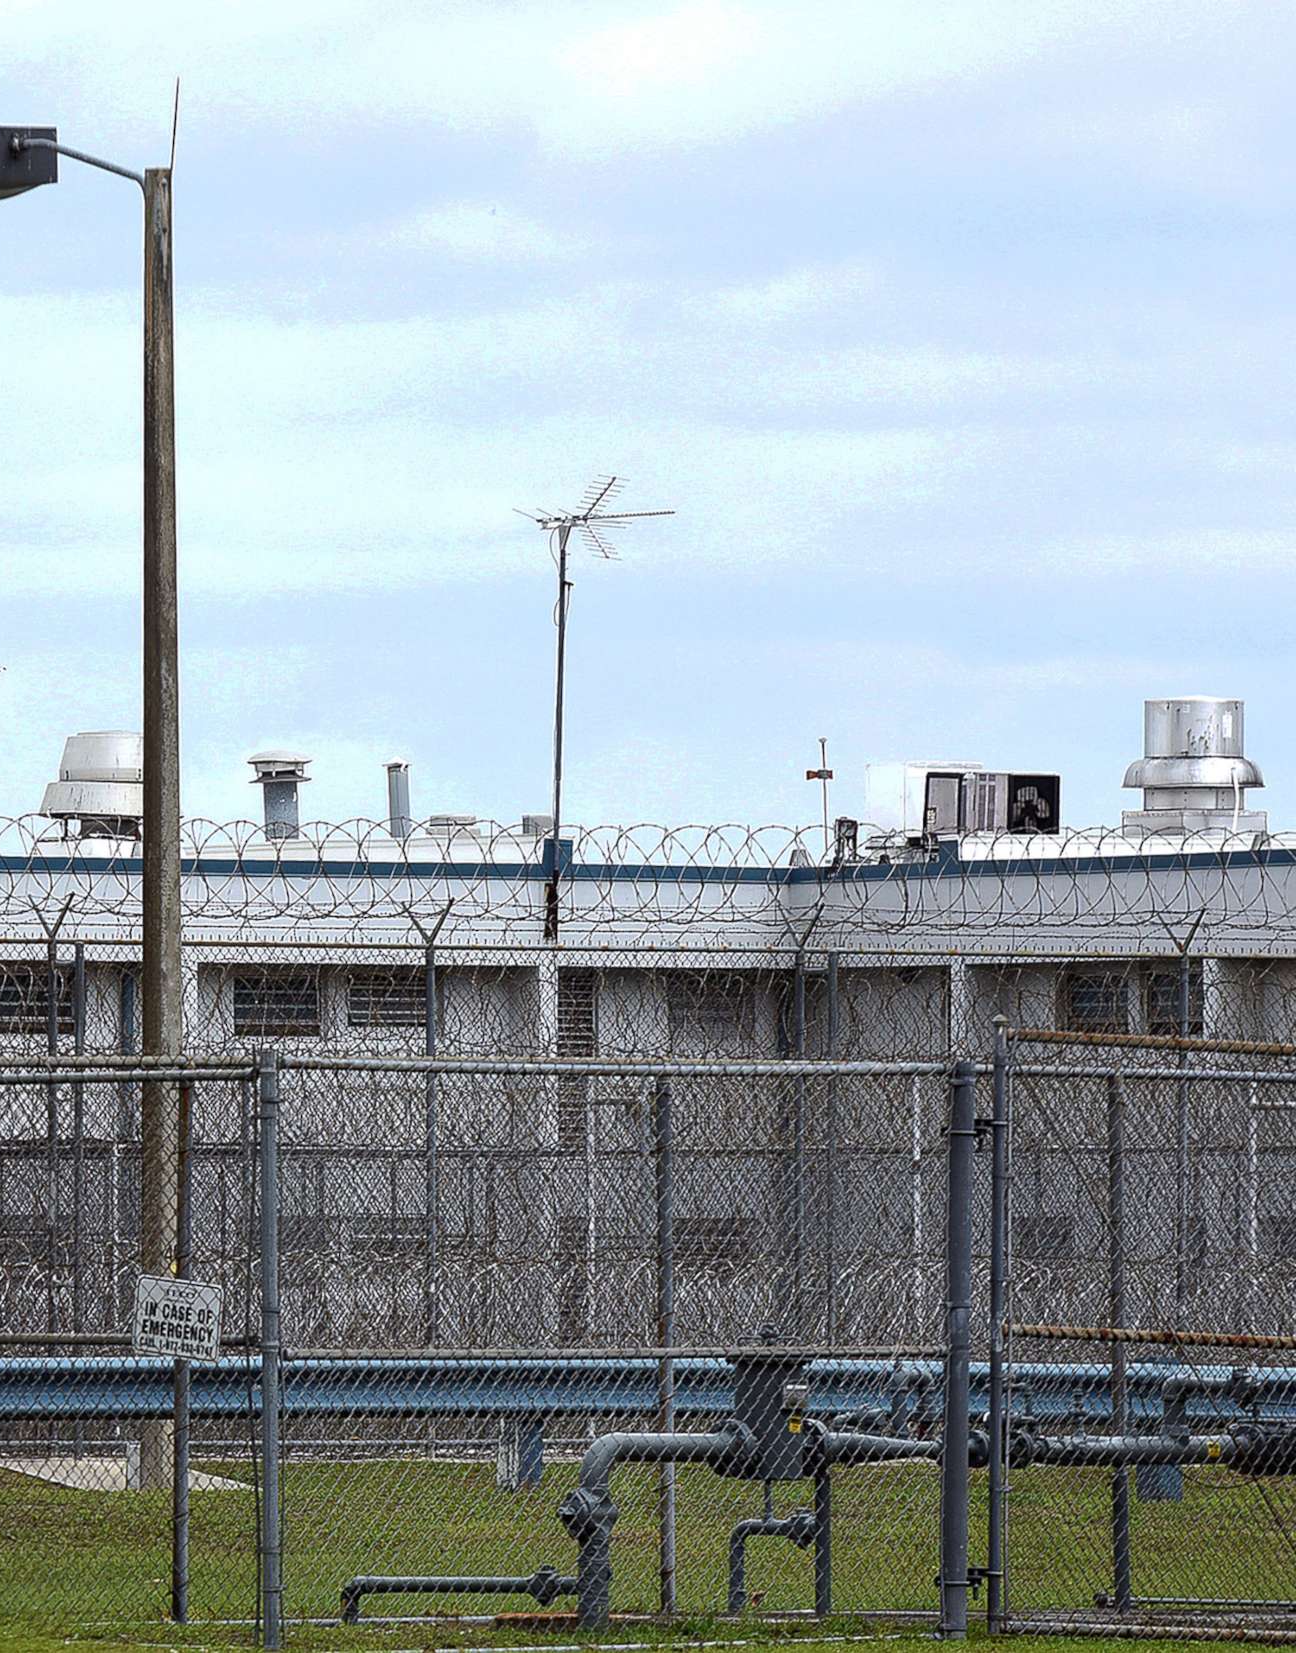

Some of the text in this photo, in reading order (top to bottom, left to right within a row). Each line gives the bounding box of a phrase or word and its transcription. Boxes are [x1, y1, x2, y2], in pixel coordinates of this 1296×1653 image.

[145, 1301, 214, 1325] IN CASE OF
[142, 1319, 214, 1343] EMERGENCY
